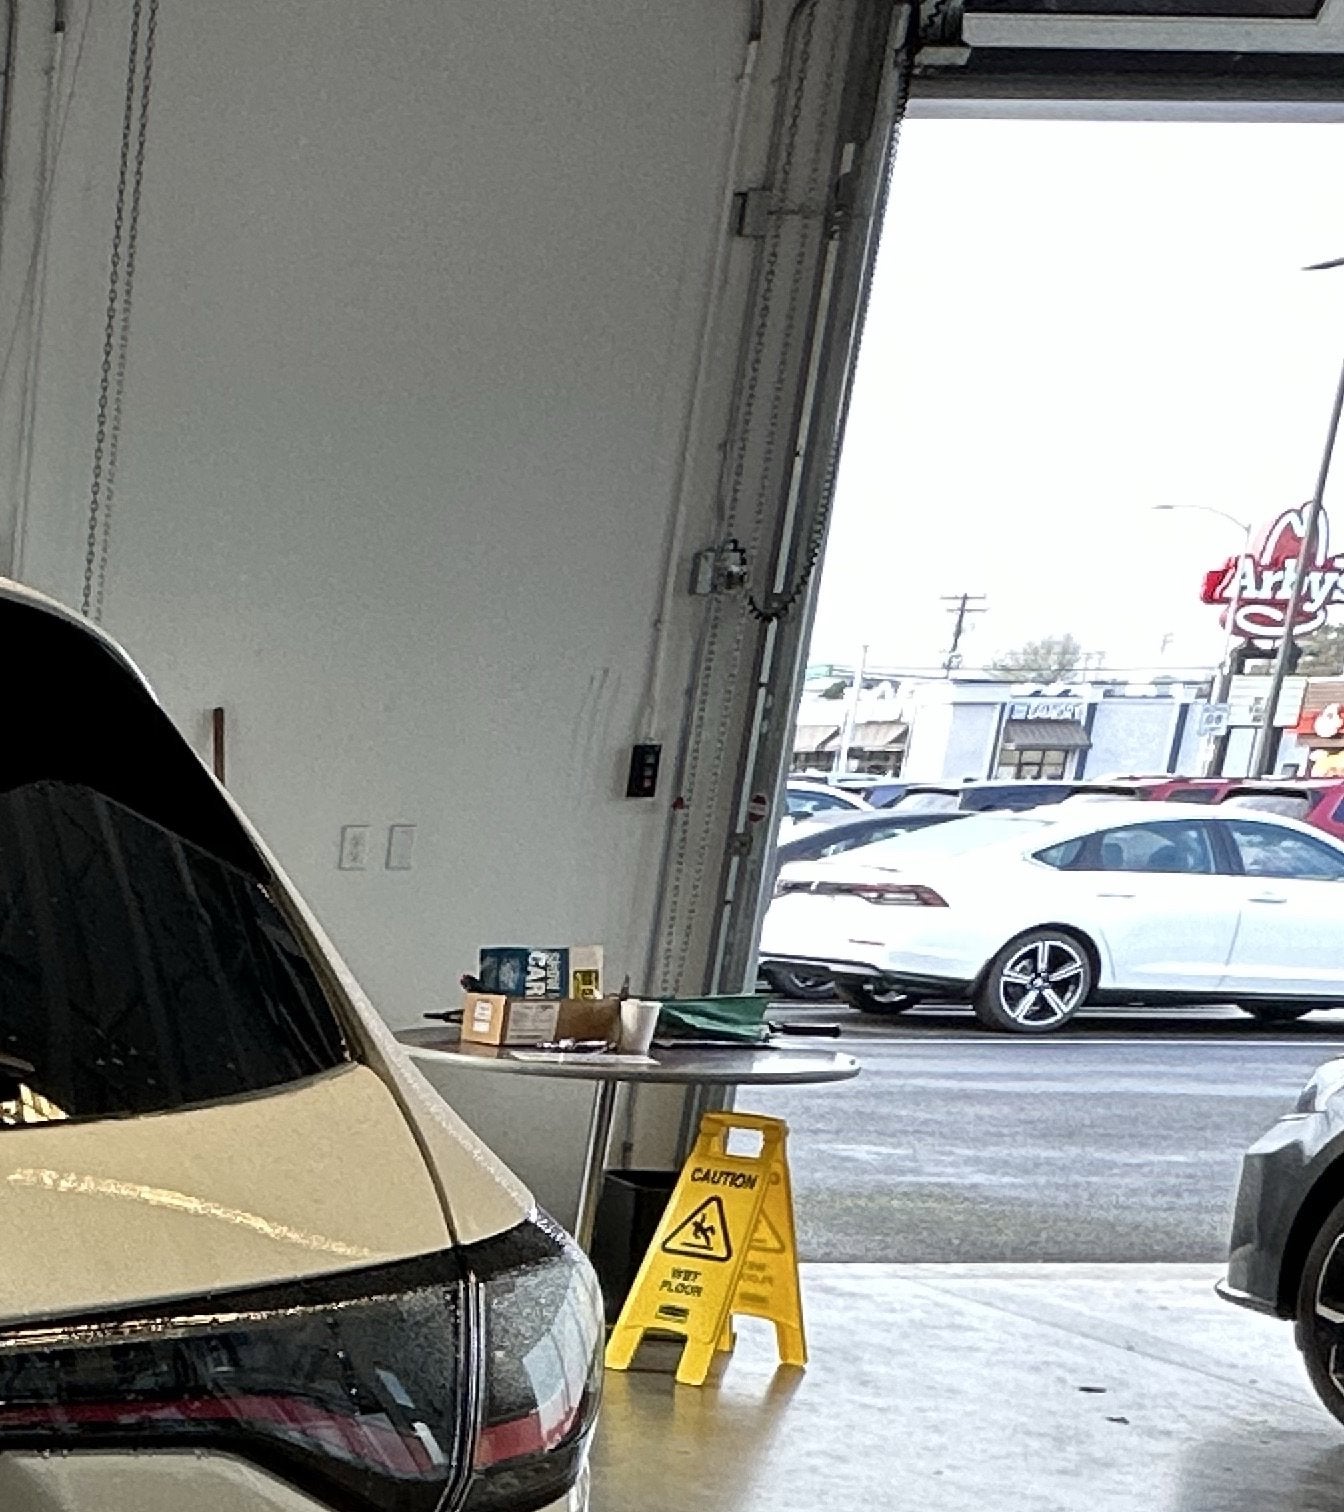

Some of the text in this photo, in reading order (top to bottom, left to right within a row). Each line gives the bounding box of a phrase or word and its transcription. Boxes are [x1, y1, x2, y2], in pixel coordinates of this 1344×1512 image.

[691, 1167, 758, 1190] CAUTION
[671, 1268, 702, 1282] WET
[659, 1280, 703, 1297] FLOOR
